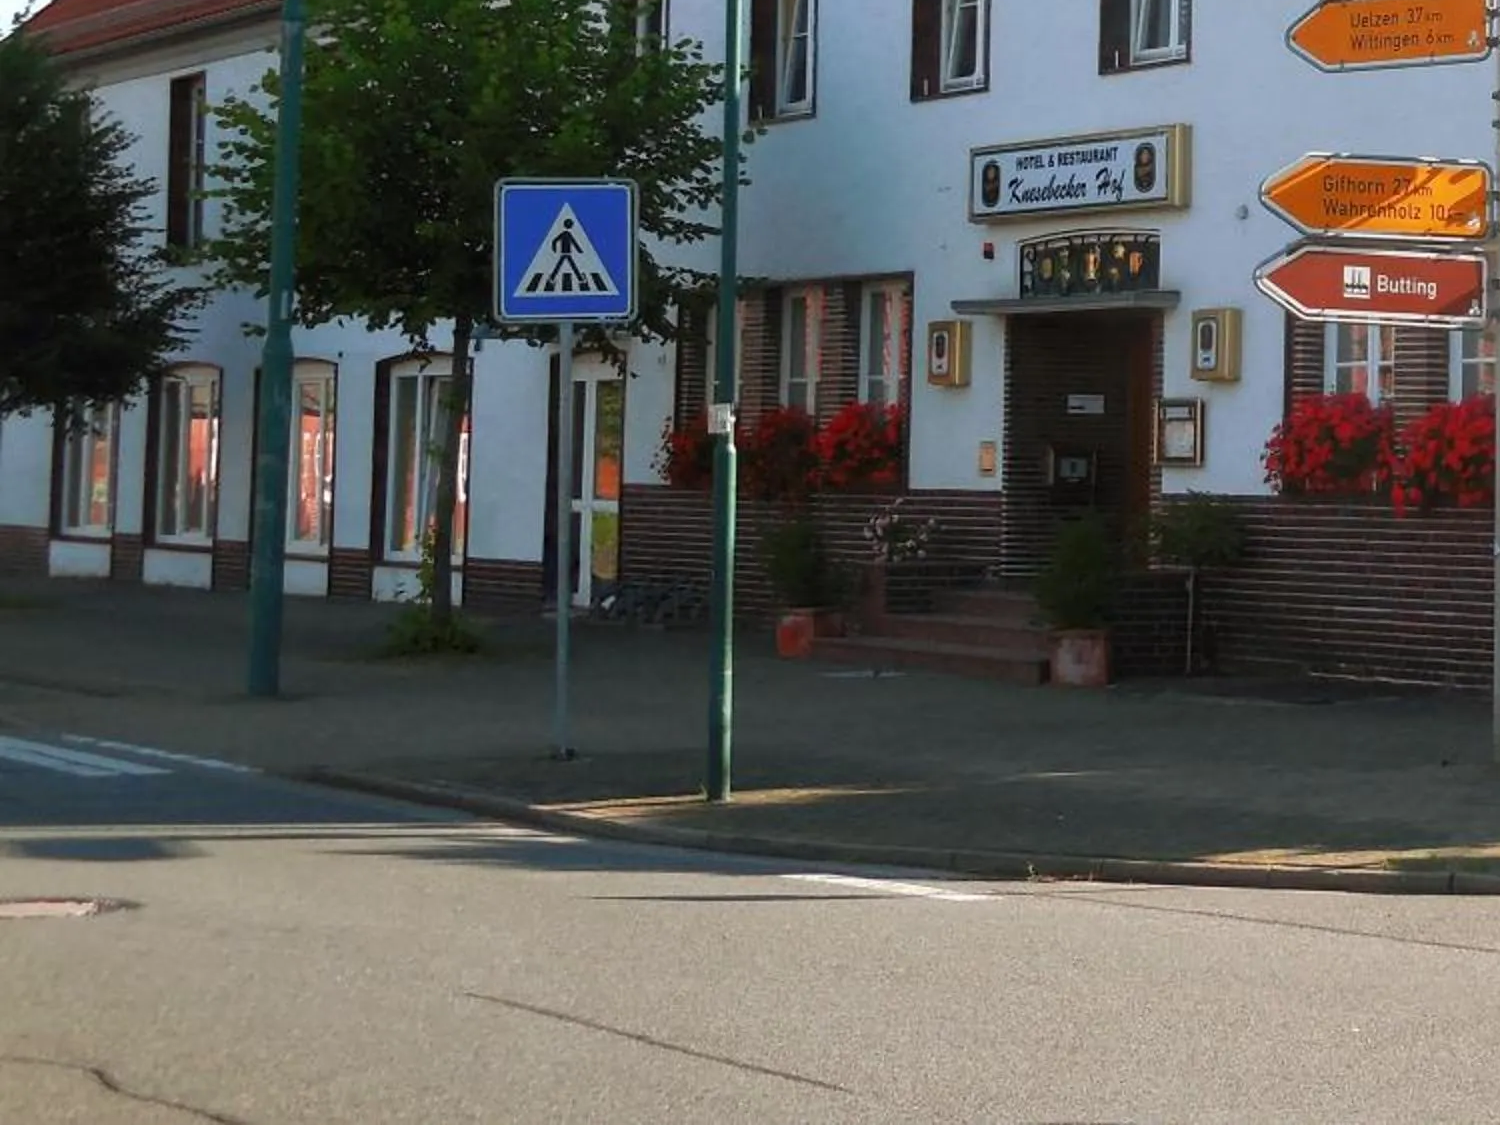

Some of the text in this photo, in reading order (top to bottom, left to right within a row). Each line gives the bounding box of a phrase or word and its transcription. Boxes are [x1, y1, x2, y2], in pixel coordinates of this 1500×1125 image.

[1350, 11, 1399, 29] Uelzen
[1407, 7, 1424, 24] 37
[1351, 29, 1455, 52] Wittingen 6 km
[1015, 155, 1045, 172] HOTEL
[1057, 146, 1118, 169] RESTAURANT
[1008, 166, 1127, 205] Knesebecker Hof
[1323, 175, 1433, 197] Gifhorn 27 km
[1323, 199, 1422, 221] Wahrenholz
[1430, 204, 1445, 221] 10
[1377, 274, 1437, 300] Butting
